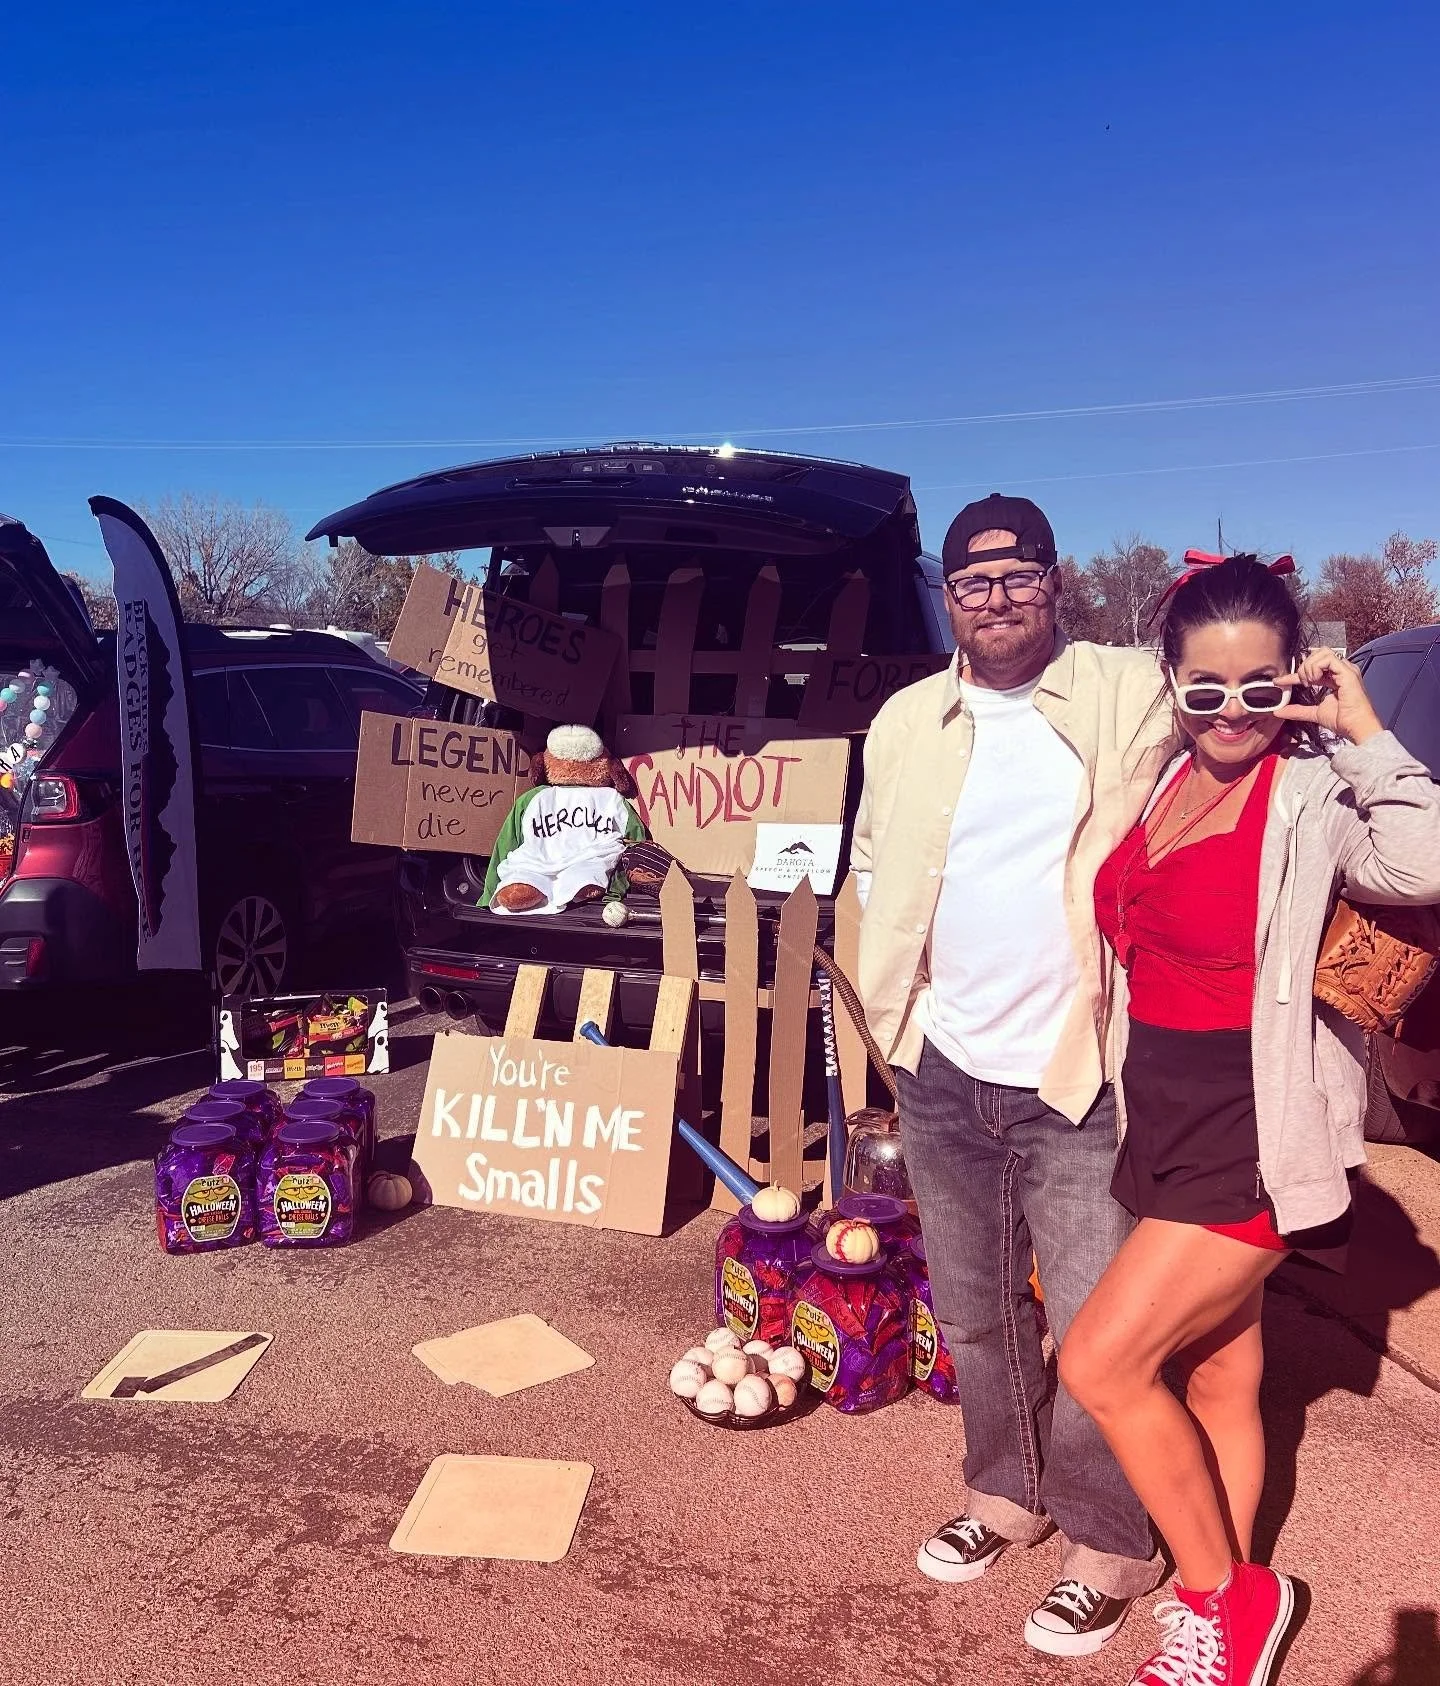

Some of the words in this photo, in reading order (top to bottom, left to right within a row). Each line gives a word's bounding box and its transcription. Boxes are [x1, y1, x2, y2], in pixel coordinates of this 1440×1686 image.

[133, 599, 148, 677] BLACK
[443, 578, 586, 665] HEROES
[472, 634, 524, 660] get
[124, 600, 142, 752] BADGES
[428, 647, 570, 706] remembered
[391, 722, 530, 777] LEGEND
[671, 715, 745, 760] THE
[129, 762, 142, 834] FOR
[421, 780, 504, 808] never
[628, 752, 802, 829] SANDLOT
[417, 812, 466, 839] die
[489, 1044, 574, 1092] You're
[582, 1103, 647, 1153] ME
[189, 1199, 237, 1217] HALLOWEEN
[281, 1200, 327, 1213] HALLOWEEN
[458, 1152, 605, 1216] Smalls
[796, 1331, 835, 1363] HALLOWEEN
